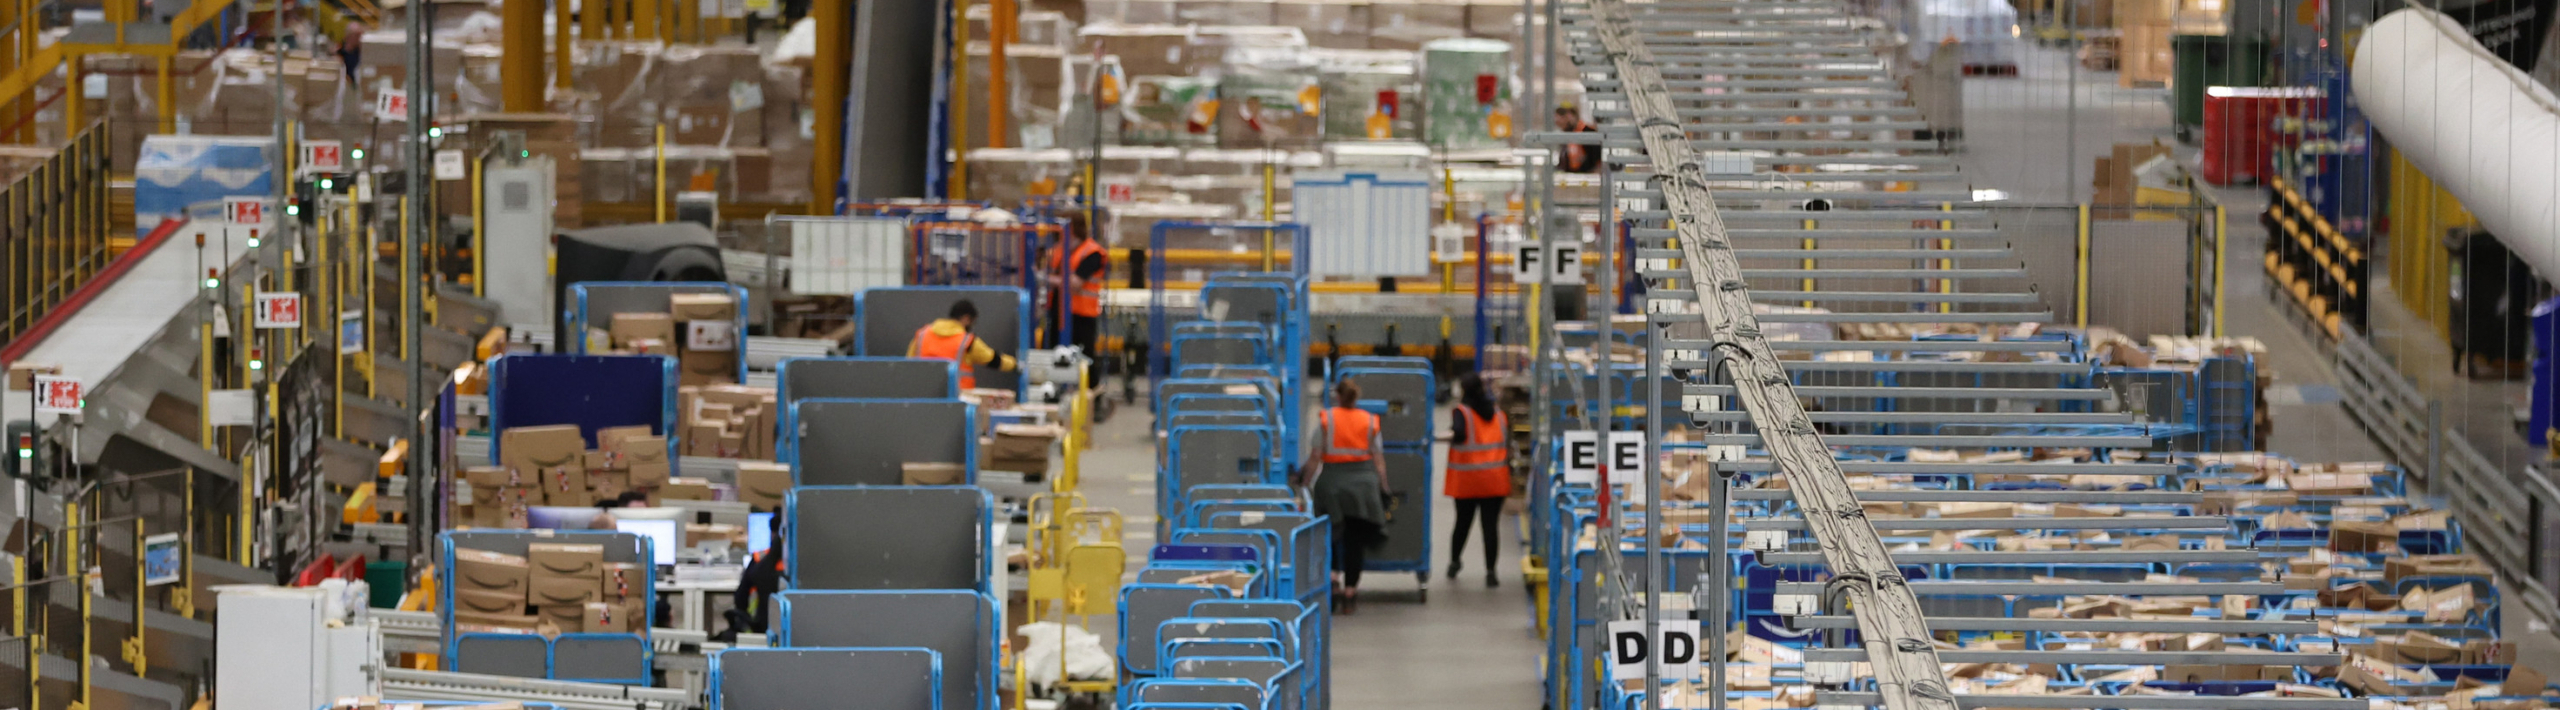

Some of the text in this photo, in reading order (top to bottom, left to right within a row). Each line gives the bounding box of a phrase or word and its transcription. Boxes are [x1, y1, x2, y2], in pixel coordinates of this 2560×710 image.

[1520, 247, 1539, 272] F
[1557, 249, 1576, 273] F
[1572, 442, 1596, 469] E
[1616, 443, 1639, 470] E
[1616, 631, 1648, 665] D
[1664, 632, 1694, 664] D
